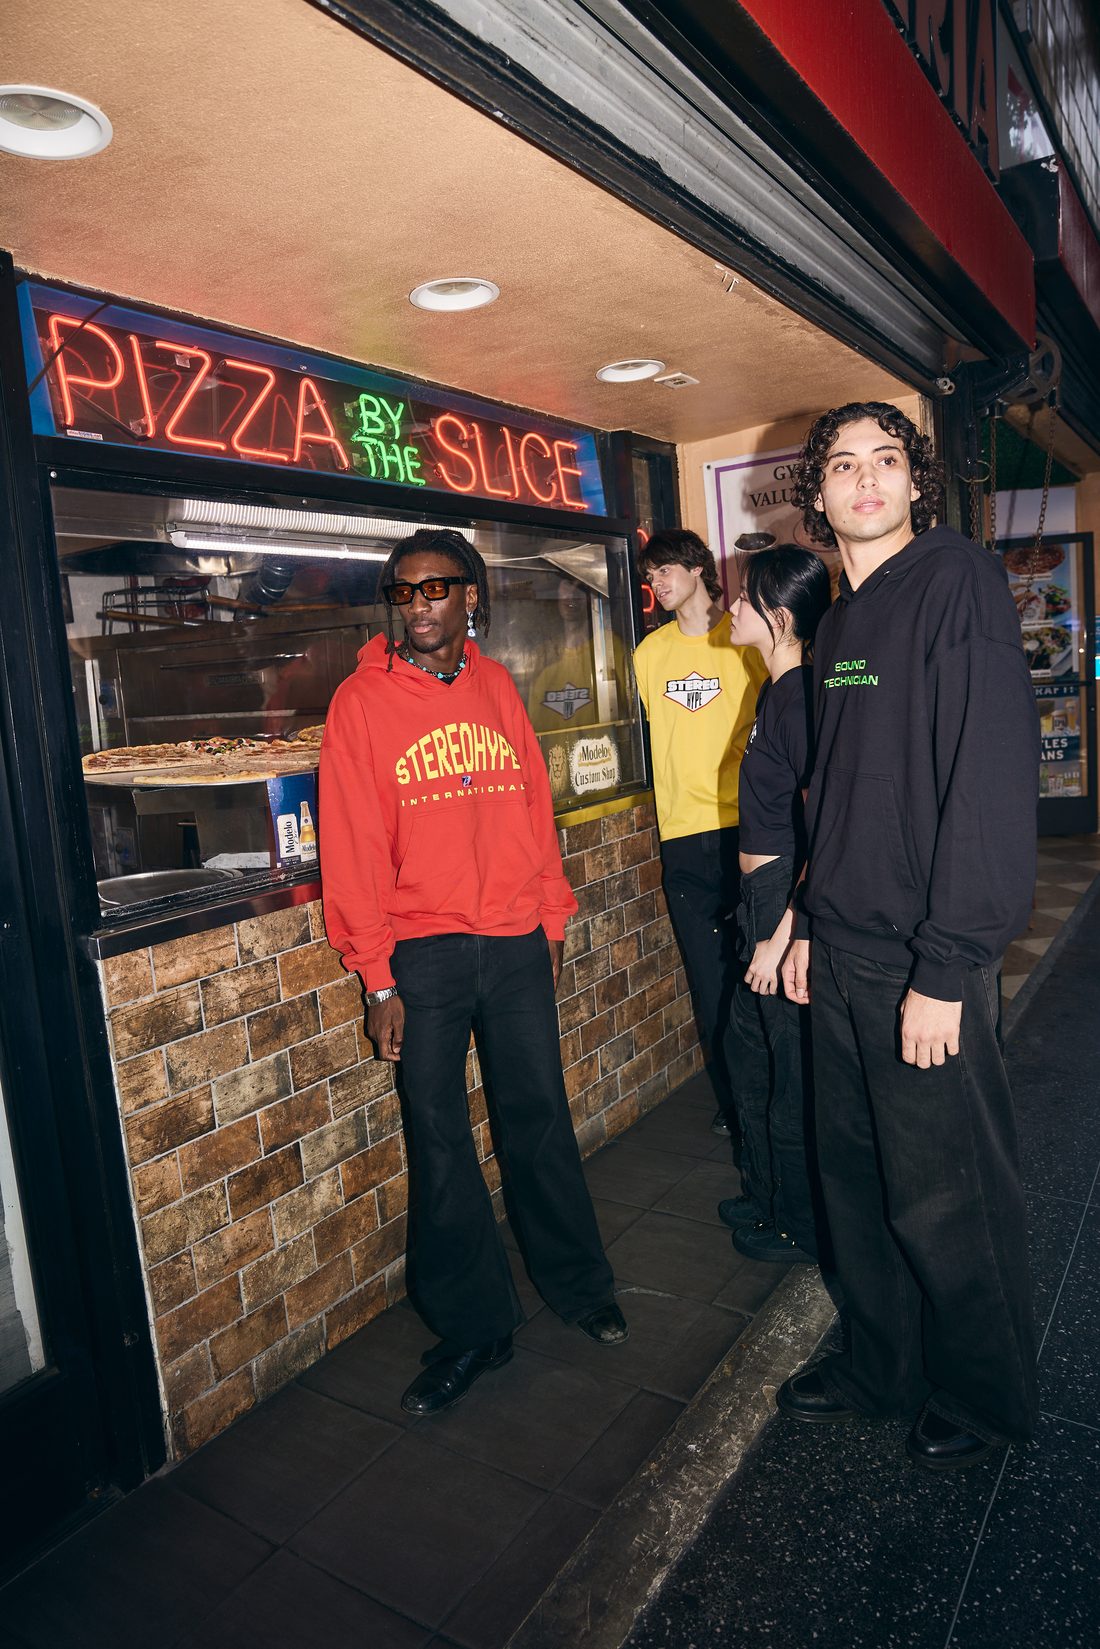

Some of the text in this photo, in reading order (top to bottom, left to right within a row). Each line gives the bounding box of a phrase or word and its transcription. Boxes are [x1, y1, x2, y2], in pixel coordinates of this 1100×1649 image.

[49, 314, 349, 471] PIZZA
[358, 393, 405, 440] BY
[352, 436, 426, 486] THE
[434, 413, 589, 509] SLICE
[834, 659, 867, 672] SOUND
[667, 678, 720, 692] STEREO
[823, 674, 879, 689] TECHNICIAN
[686, 691, 702, 710] HYPE
[395, 722, 521, 785] STEREOHYPE
[581, 743, 609, 762] Modelo
[1041, 737, 1068, 750] LES
[574, 771, 601, 787] Custom
[401, 783, 526, 807] INTERNATIONAL
[284, 821, 295, 853] Modelo
